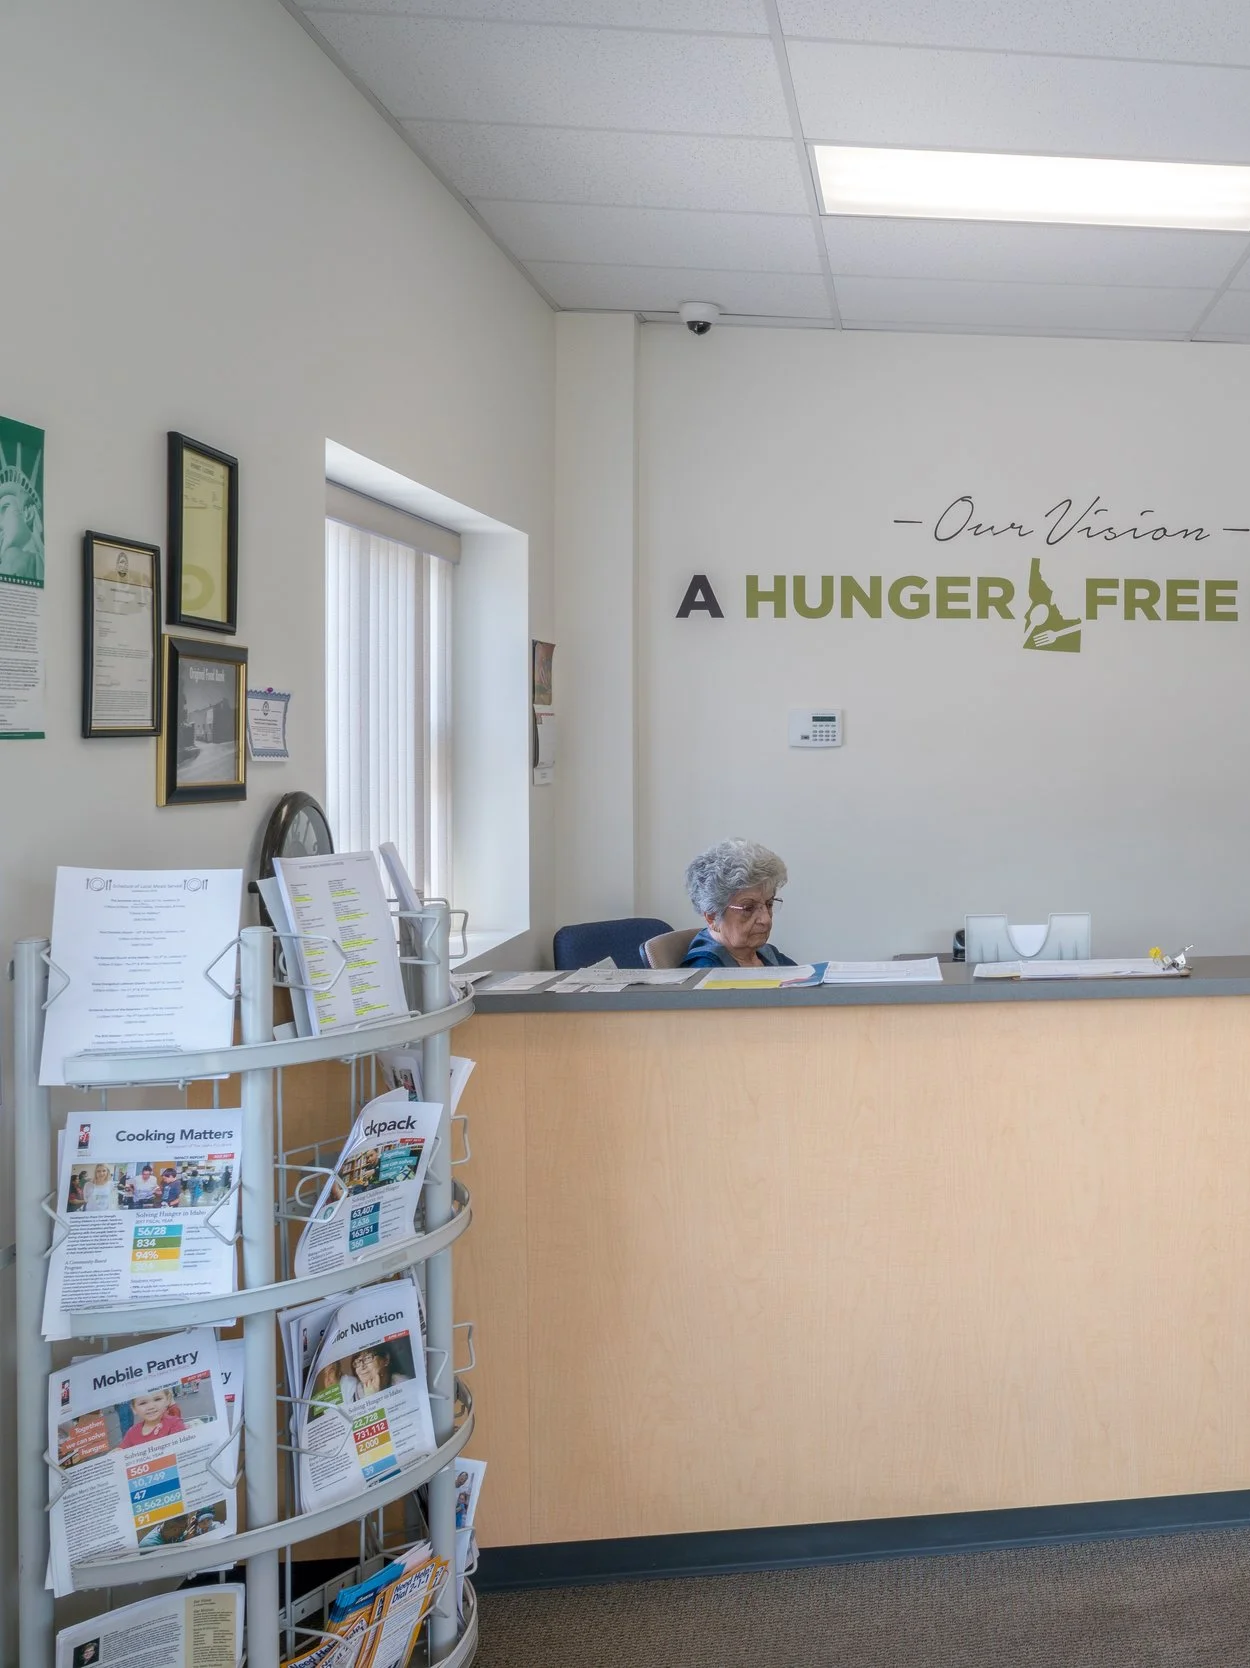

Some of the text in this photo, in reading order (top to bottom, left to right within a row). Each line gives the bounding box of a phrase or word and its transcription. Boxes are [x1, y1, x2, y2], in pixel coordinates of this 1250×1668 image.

[933, 495, 1211, 546] Our Vision
[675, 574, 724, 619] A
[745, 574, 1016, 620] HUNGER
[1085, 578, 1238, 622] FREE
[116, 1128, 234, 1144] Cooking Matters
[136, 1211, 157, 1220] Solving
[158, 1210, 182, 1219] Hunger
[352, 1204, 375, 1219] 63,407
[136, 1226, 167, 1236] 56/28
[351, 1224, 374, 1239] 163/51
[136, 1238, 157, 1248] 834
[135, 1250, 159, 1261] 94%
[350, 1309, 404, 1335] Nutrition
[93, 1350, 199, 1390] Mobile Pantry
[75, 1420, 105, 1433] Together,
[353, 1412, 379, 1429] 22,728
[355, 1422, 385, 1441] 731,112
[66, 1431, 106, 1450] we can solve
[124, 1449, 147, 1461] Solving
[148, 1442, 171, 1454] Hunger
[179, 1434, 197, 1444] Idaho
[358, 1438, 380, 1452] 2,000
[81, 1443, 107, 1455] hunger.
[130, 1463, 150, 1476] 560
[132, 1471, 165, 1487] 10,749
[133, 1490, 147, 1500] 47
[135, 1492, 181, 1513] 3,562,069
[137, 1514, 150, 1525] 91
[394, 1563, 435, 1594] Need Help?
[392, 1586, 408, 1604] Dial
[408, 1573, 430, 1593] 2-1-1
[316, 1640, 337, 1658] Hel
